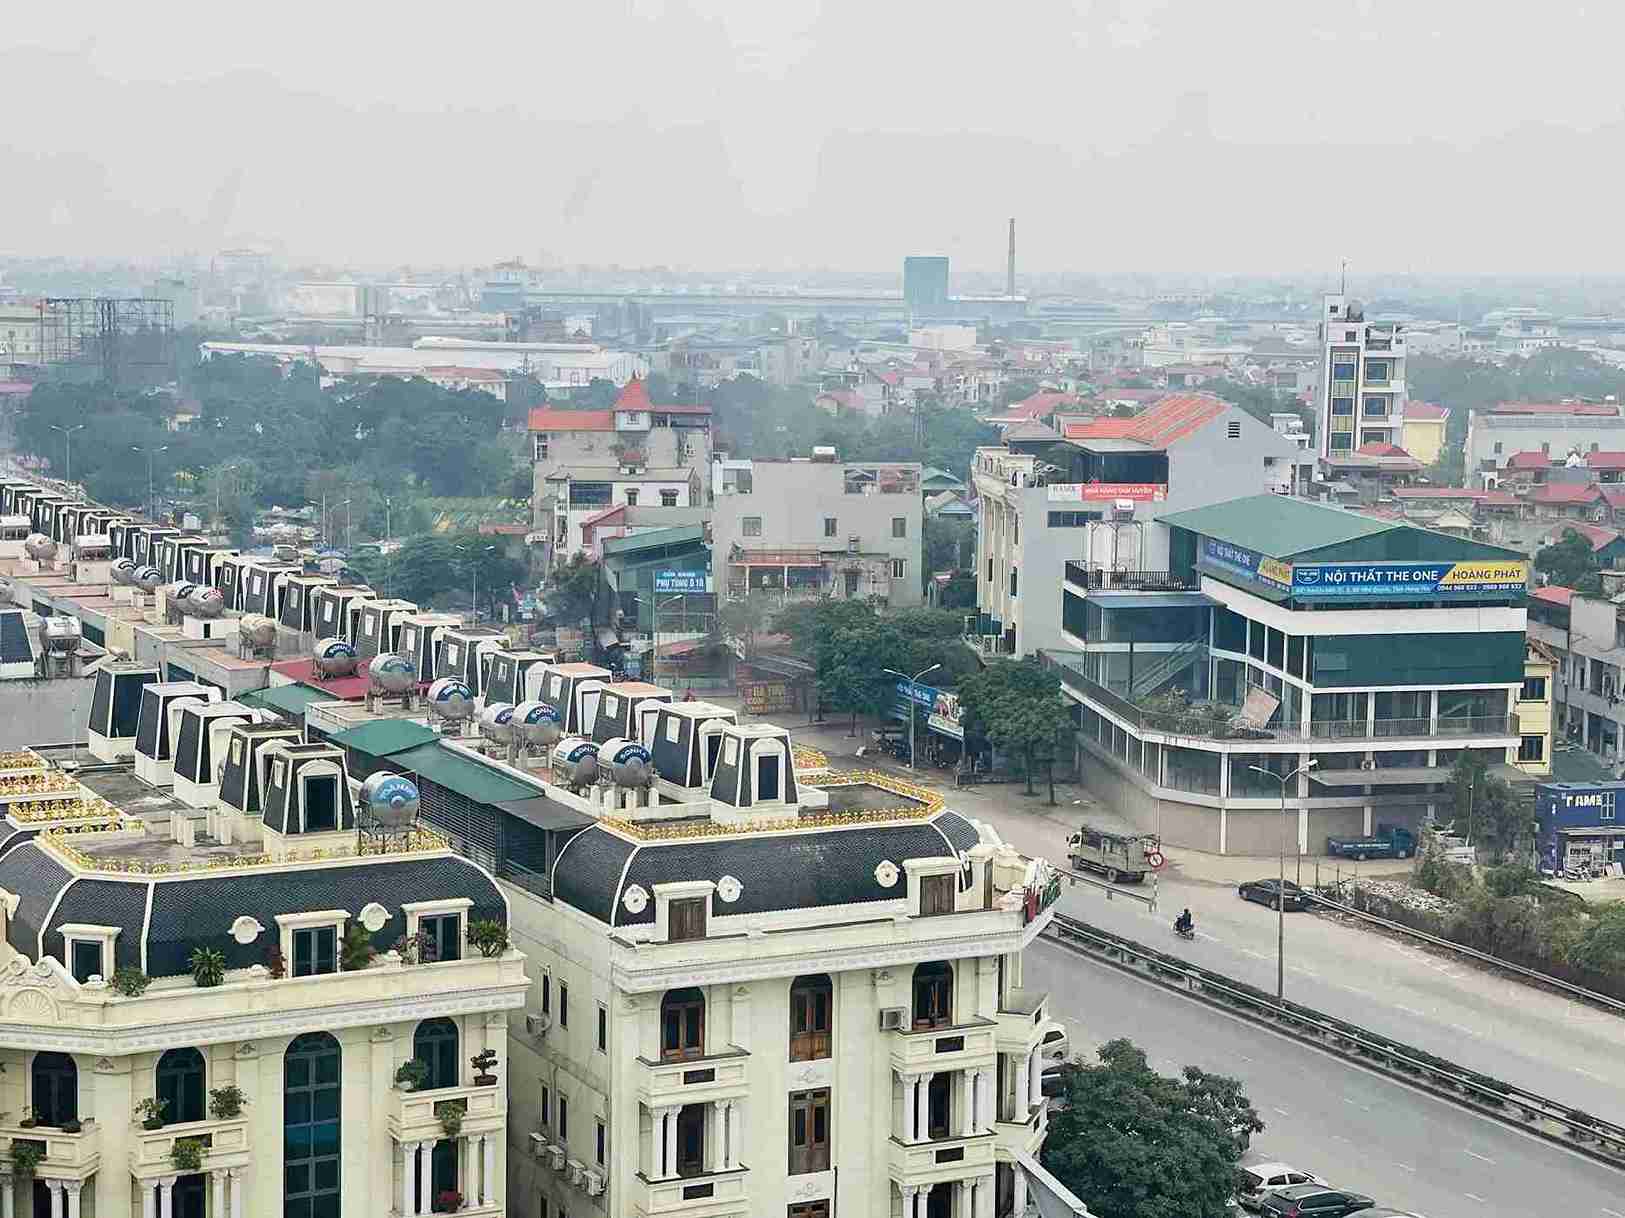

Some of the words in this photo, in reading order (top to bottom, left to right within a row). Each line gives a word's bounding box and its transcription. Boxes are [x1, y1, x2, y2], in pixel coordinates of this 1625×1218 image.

[1324, 569, 1347, 584] NỘI
[1350, 567, 1384, 582] THẤT
[1386, 571, 1409, 582] THE
[1412, 570, 1438, 581] ONE
